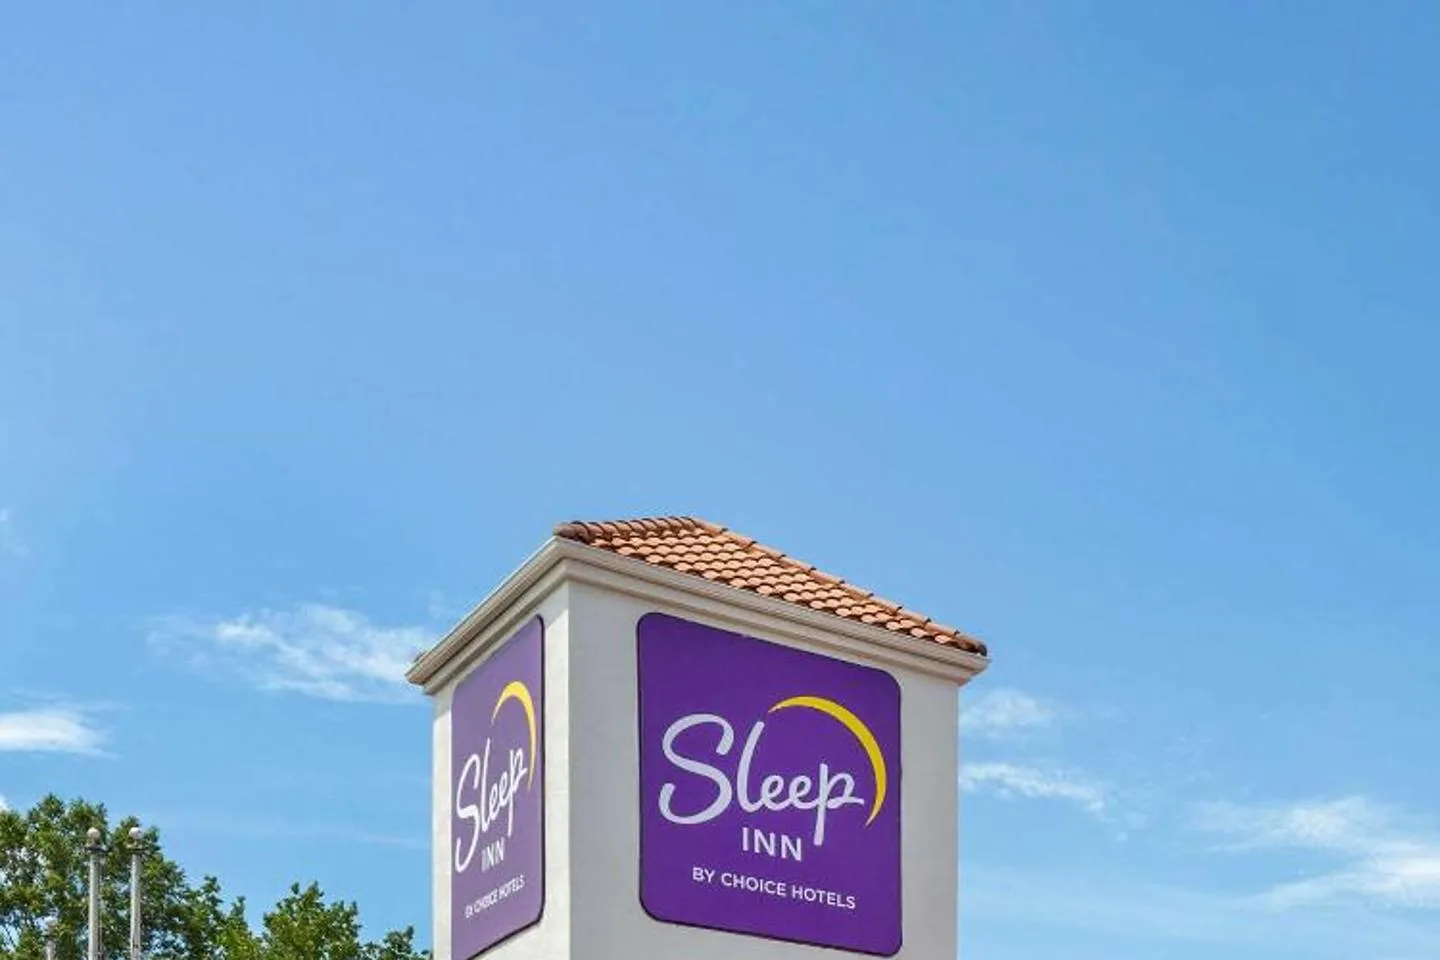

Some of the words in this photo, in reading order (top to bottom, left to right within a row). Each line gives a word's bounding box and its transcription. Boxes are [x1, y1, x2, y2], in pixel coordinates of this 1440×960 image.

[659, 713, 865, 846] Sleep
[454, 738, 527, 873] Sleep
[482, 837, 505, 873] INN
[742, 826, 802, 861] INN
[692, 867, 716, 882] BY
[721, 872, 786, 896] CHOICE
[792, 885, 856, 909] HOTELS
